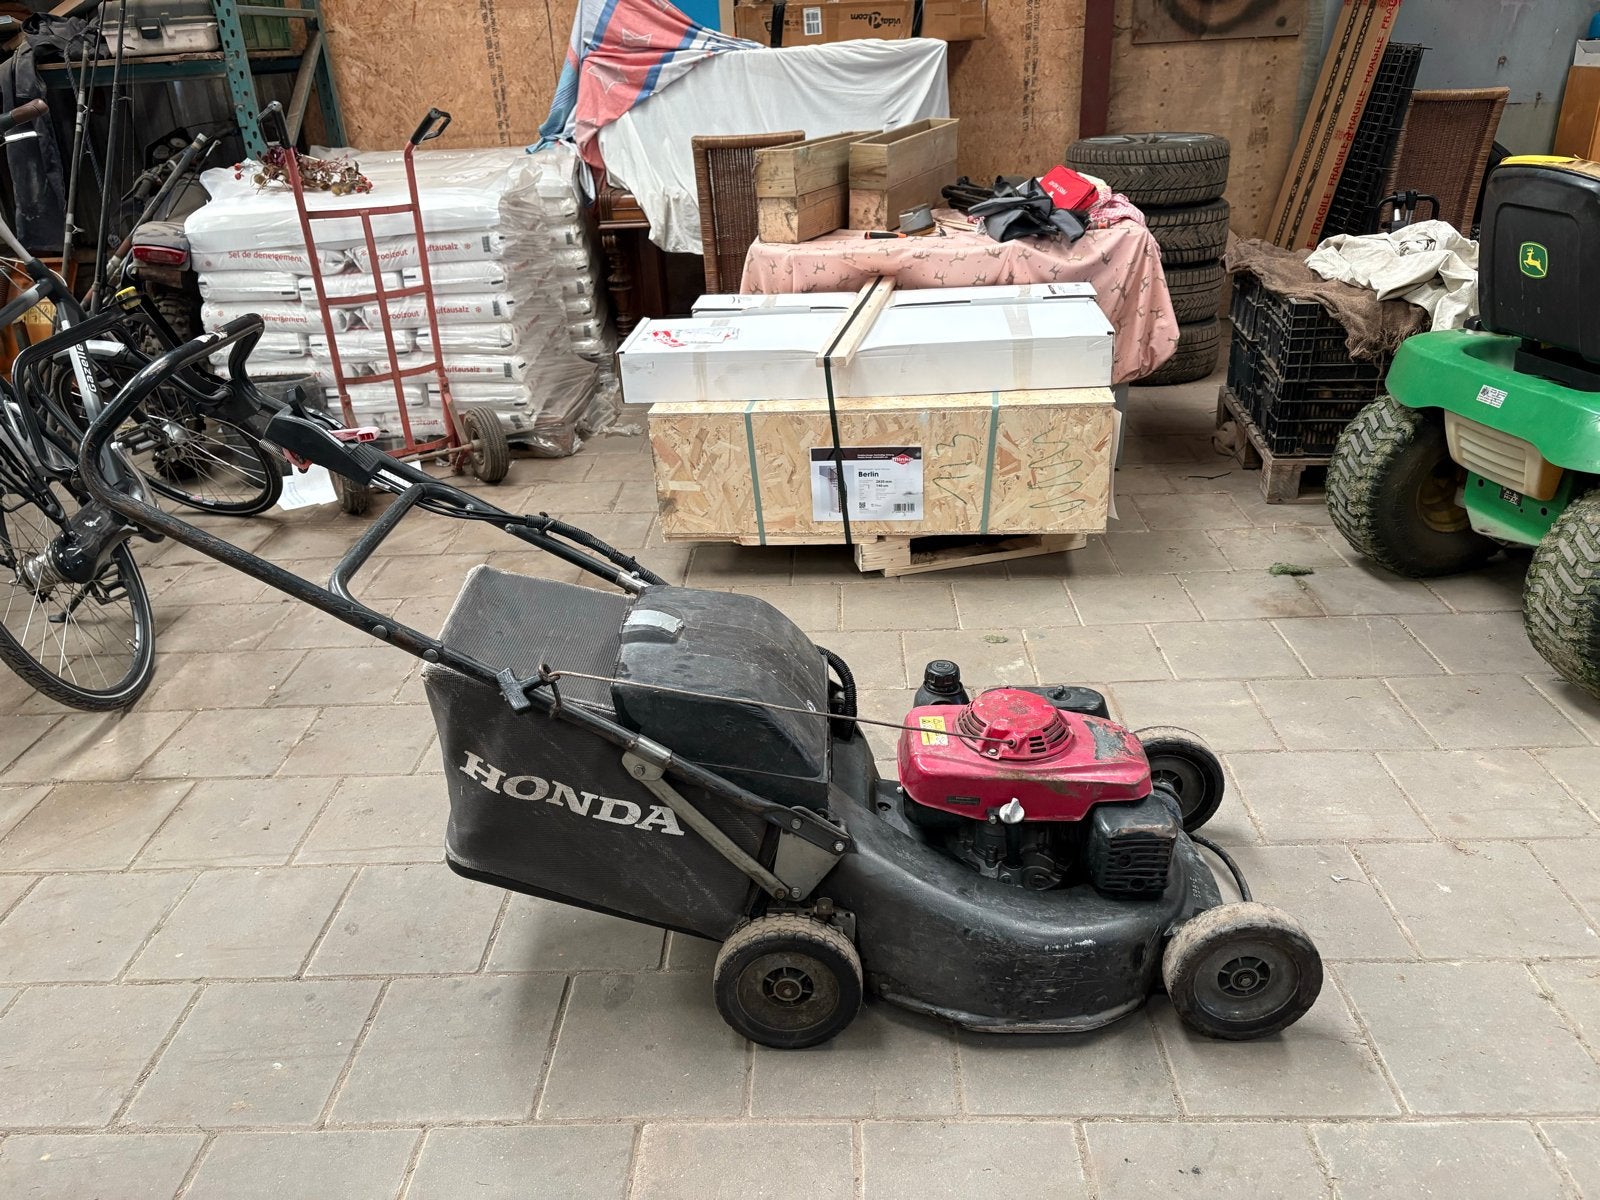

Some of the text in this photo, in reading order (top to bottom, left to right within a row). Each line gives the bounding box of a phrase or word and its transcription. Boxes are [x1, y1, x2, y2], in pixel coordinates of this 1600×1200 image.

[1364, 36, 1385, 84] FRAGILE
[1328, 142, 1349, 186] FRAGILE
[1310, 192, 1333, 236] FRAGILE
[241, 250, 252, 259] de
[377, 248, 409, 260] rooizout
[426, 242, 459, 253] uftausalz
[388, 310, 420, 320] rooizout
[435, 306, 470, 315] uftausalz
[459, 750, 685, 836] HONDA
